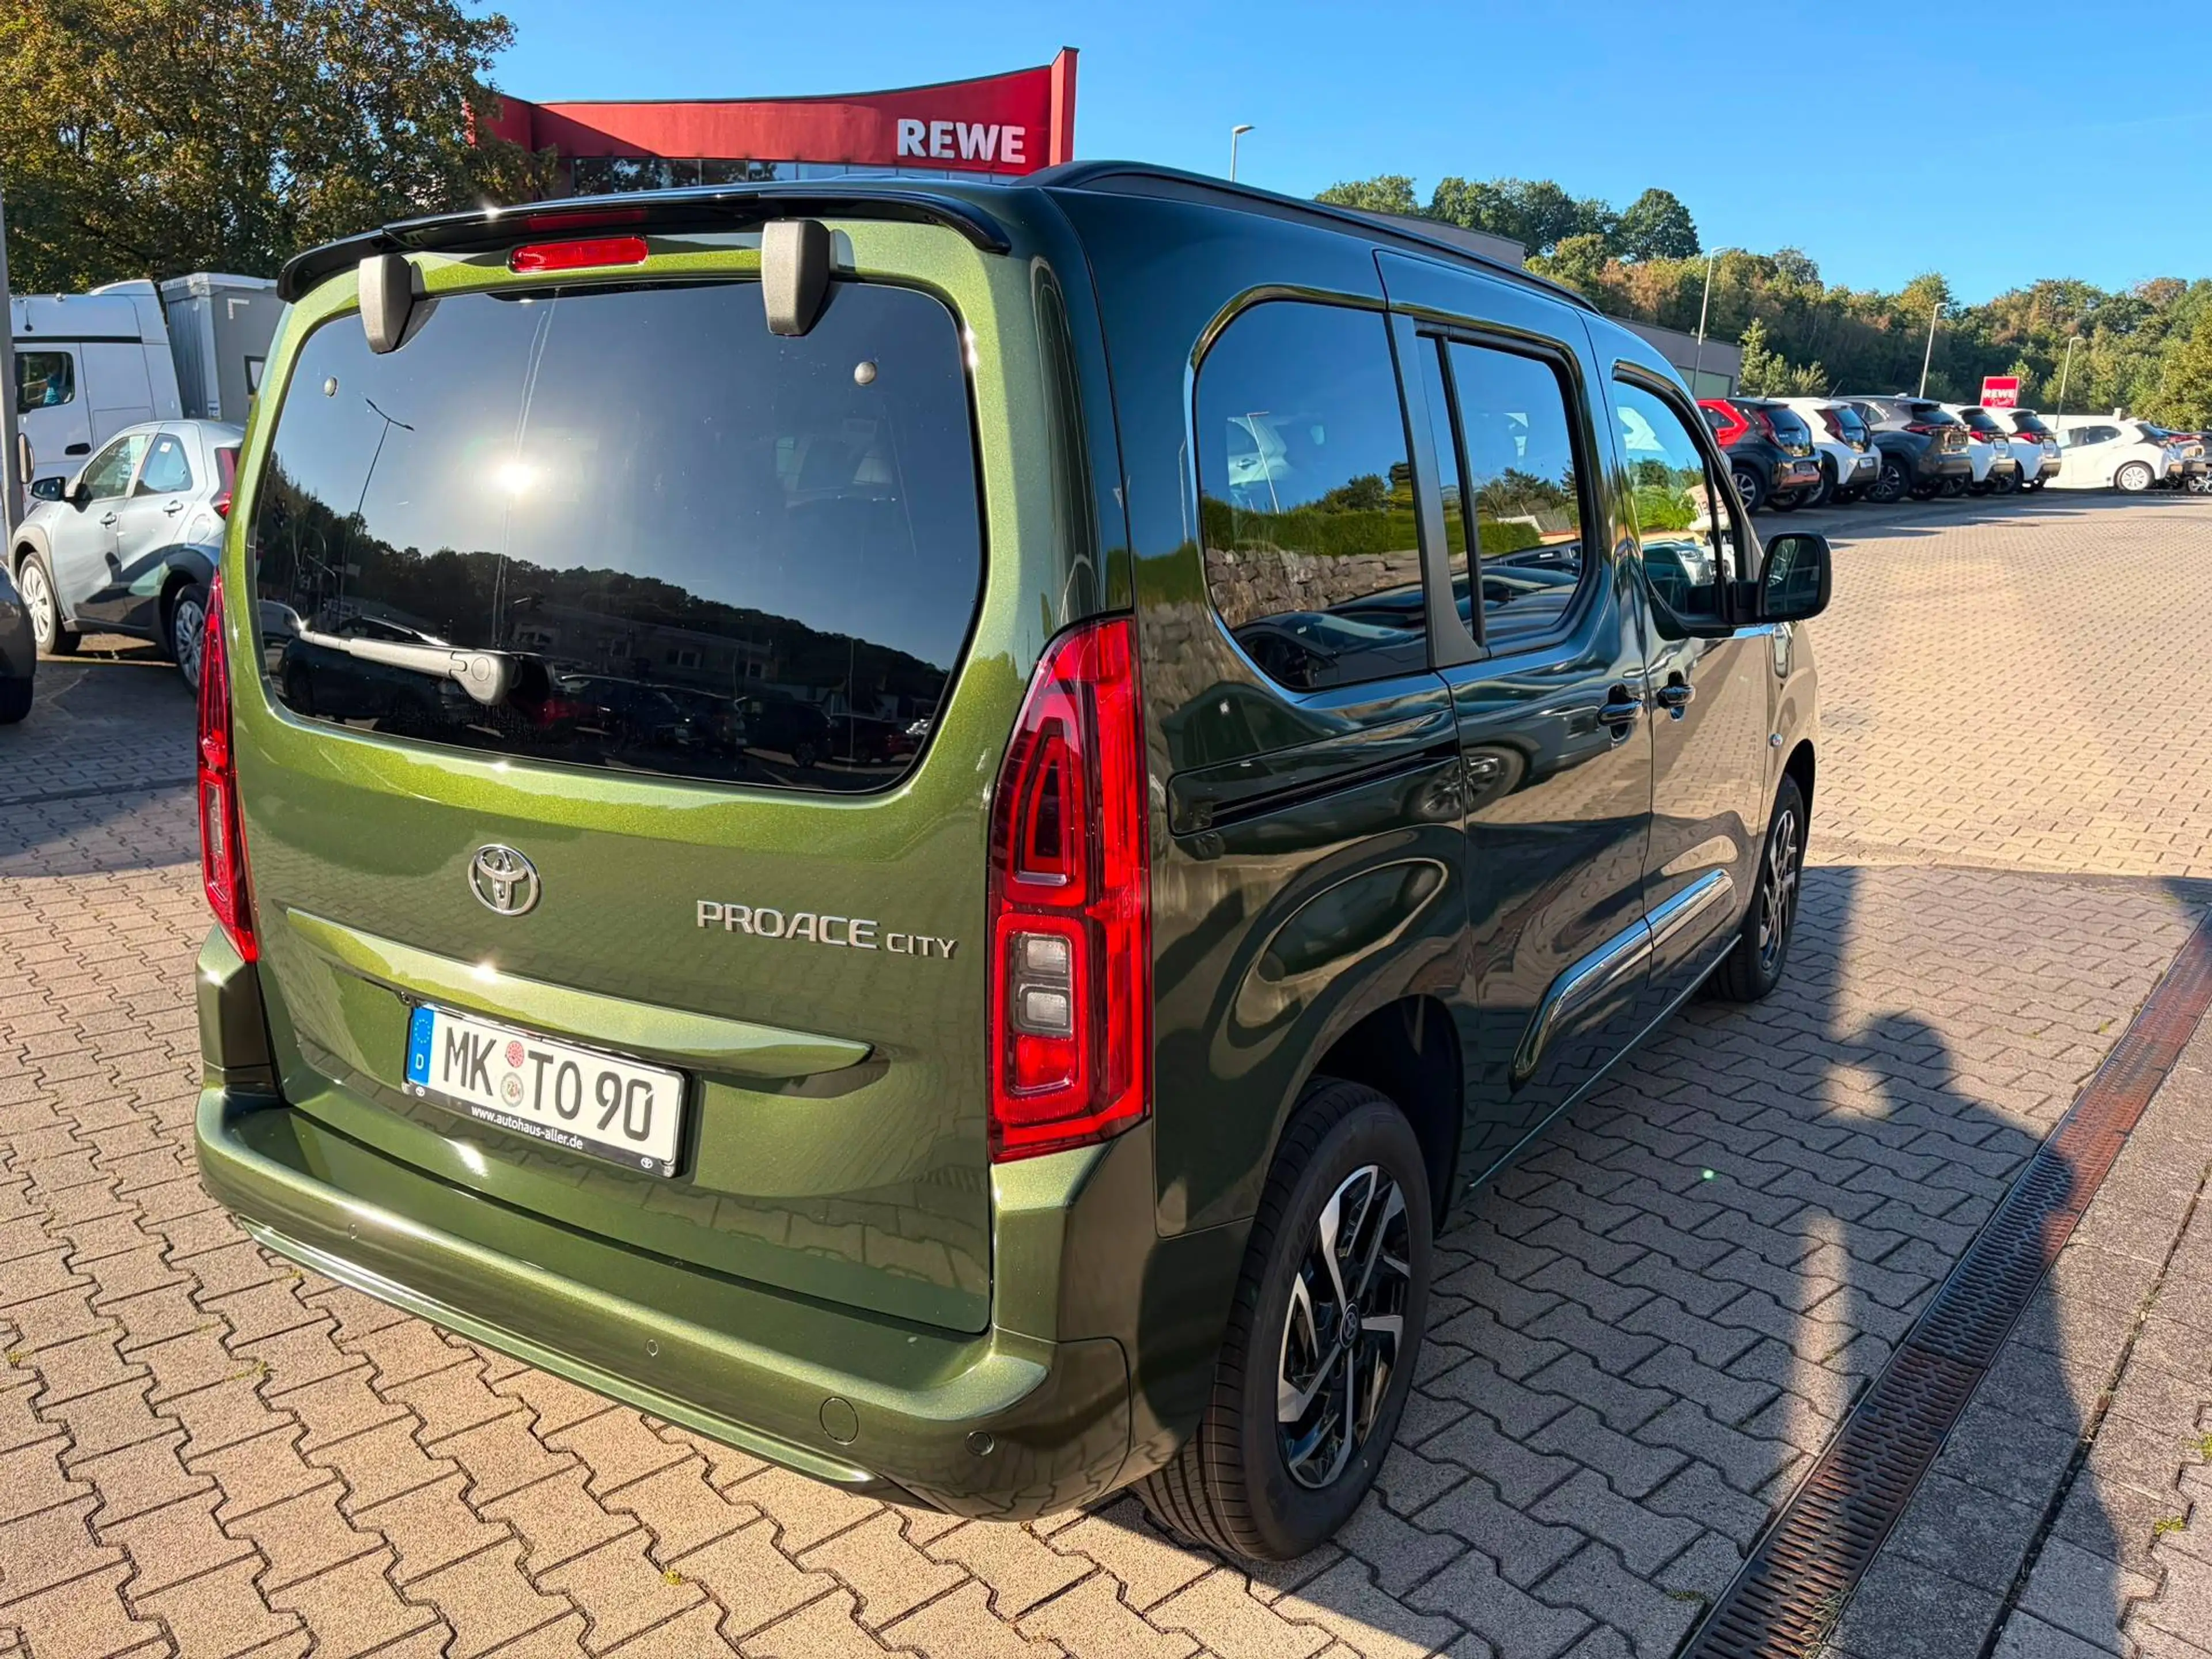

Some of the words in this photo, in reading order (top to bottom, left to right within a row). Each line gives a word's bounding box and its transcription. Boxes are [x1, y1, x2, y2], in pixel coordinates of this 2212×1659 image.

[897, 118, 1026, 164] REWE
[1983, 389, 2015, 398] REWE
[696, 899, 880, 950] PROACE
[886, 933, 959, 959] CITY
[415, 1054, 424, 1069] D
[444, 1026, 498, 1096] MK
[528, 1050, 582, 1120] TO
[595, 1071, 654, 1142] 90
[471, 1105, 584, 1149] www.autohaus-aller.de
